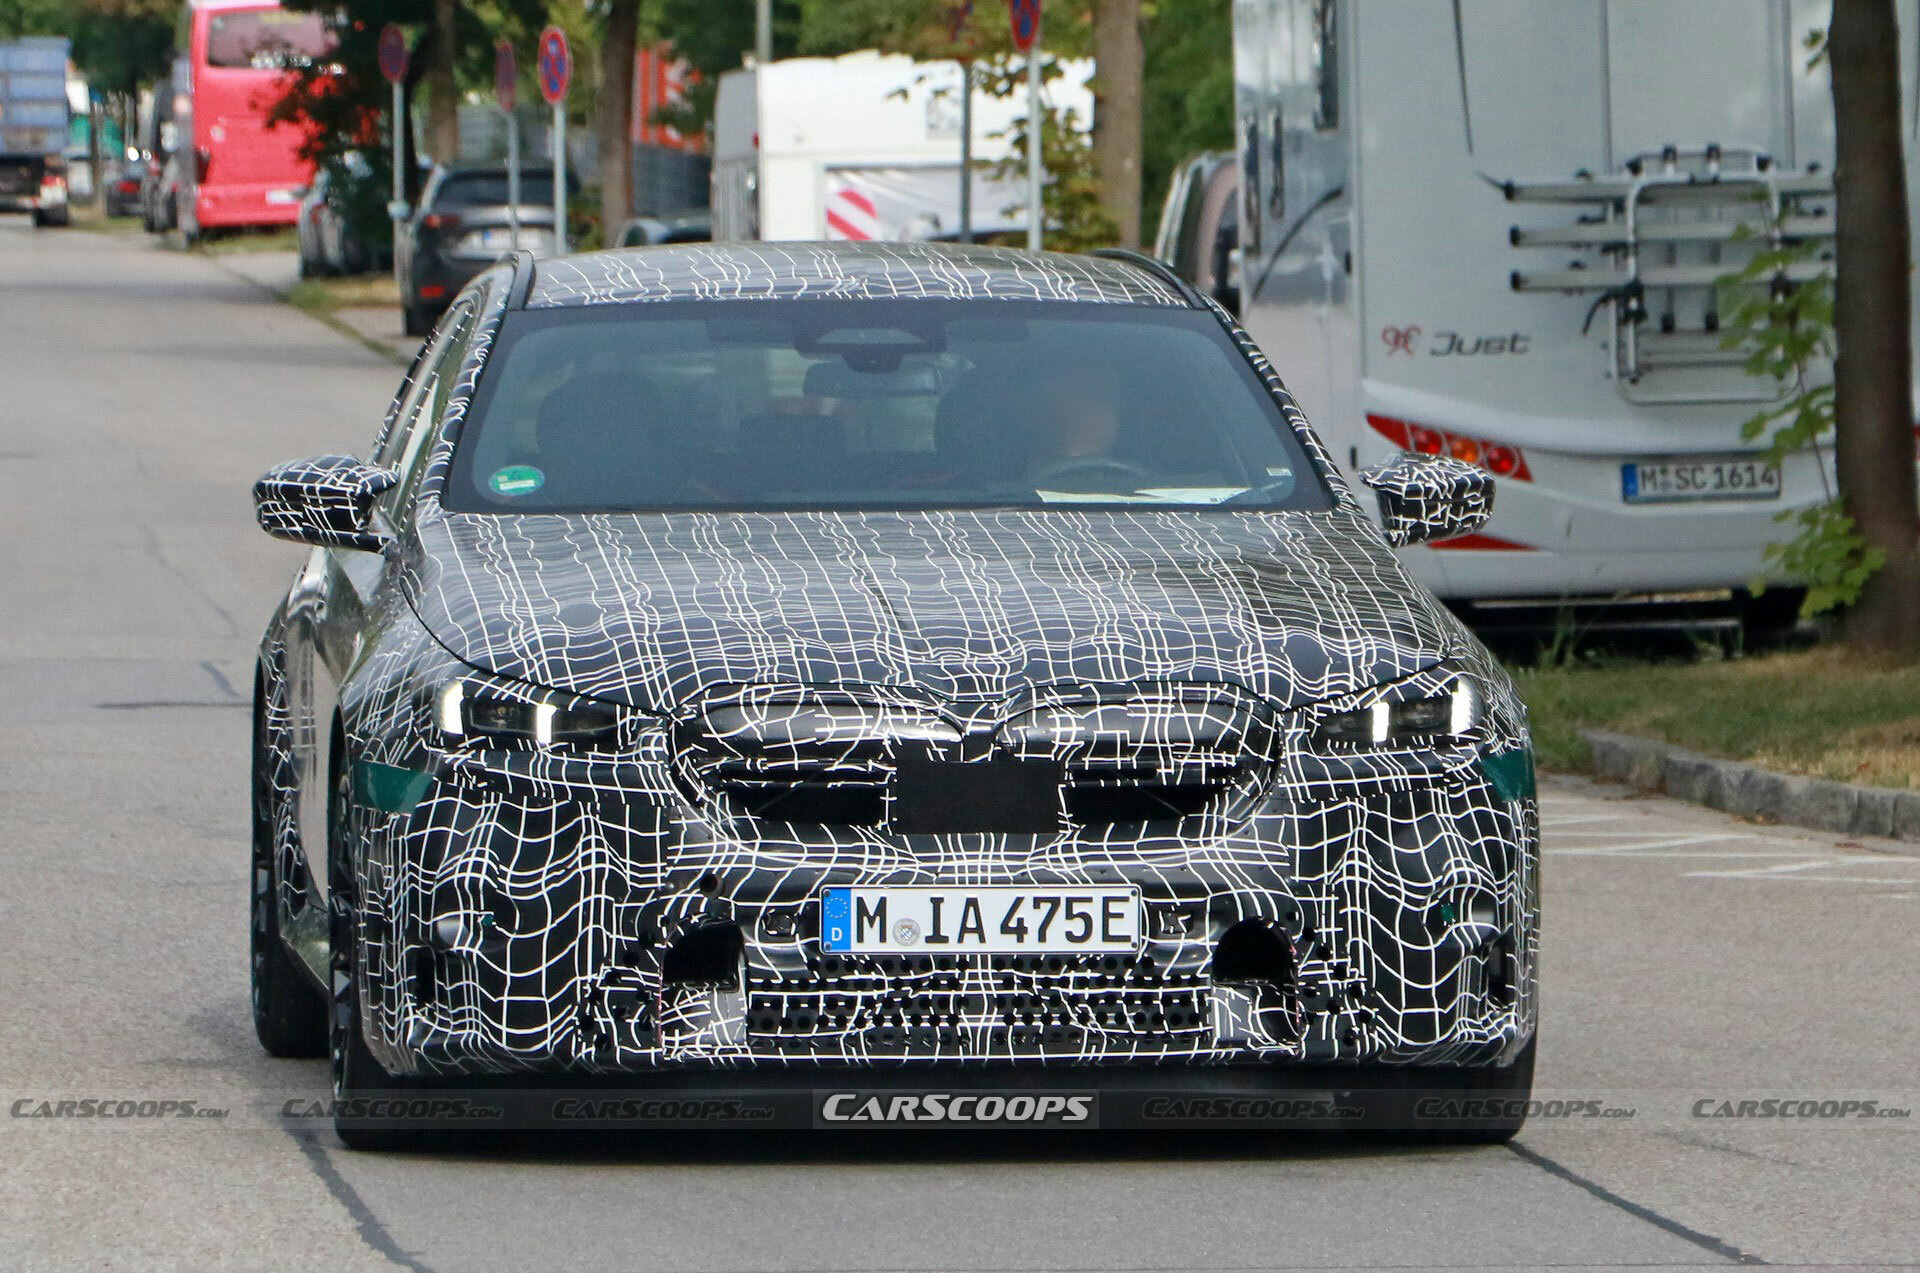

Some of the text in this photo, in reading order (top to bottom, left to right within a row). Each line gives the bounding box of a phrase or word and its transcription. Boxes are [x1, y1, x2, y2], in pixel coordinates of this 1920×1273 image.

[1430, 330, 1532, 357] Just
[1640, 467, 1657, 491] M
[1713, 464, 1774, 489] 1614
[856, 896, 1132, 943] M IA 475E
[831, 927, 843, 942] D
